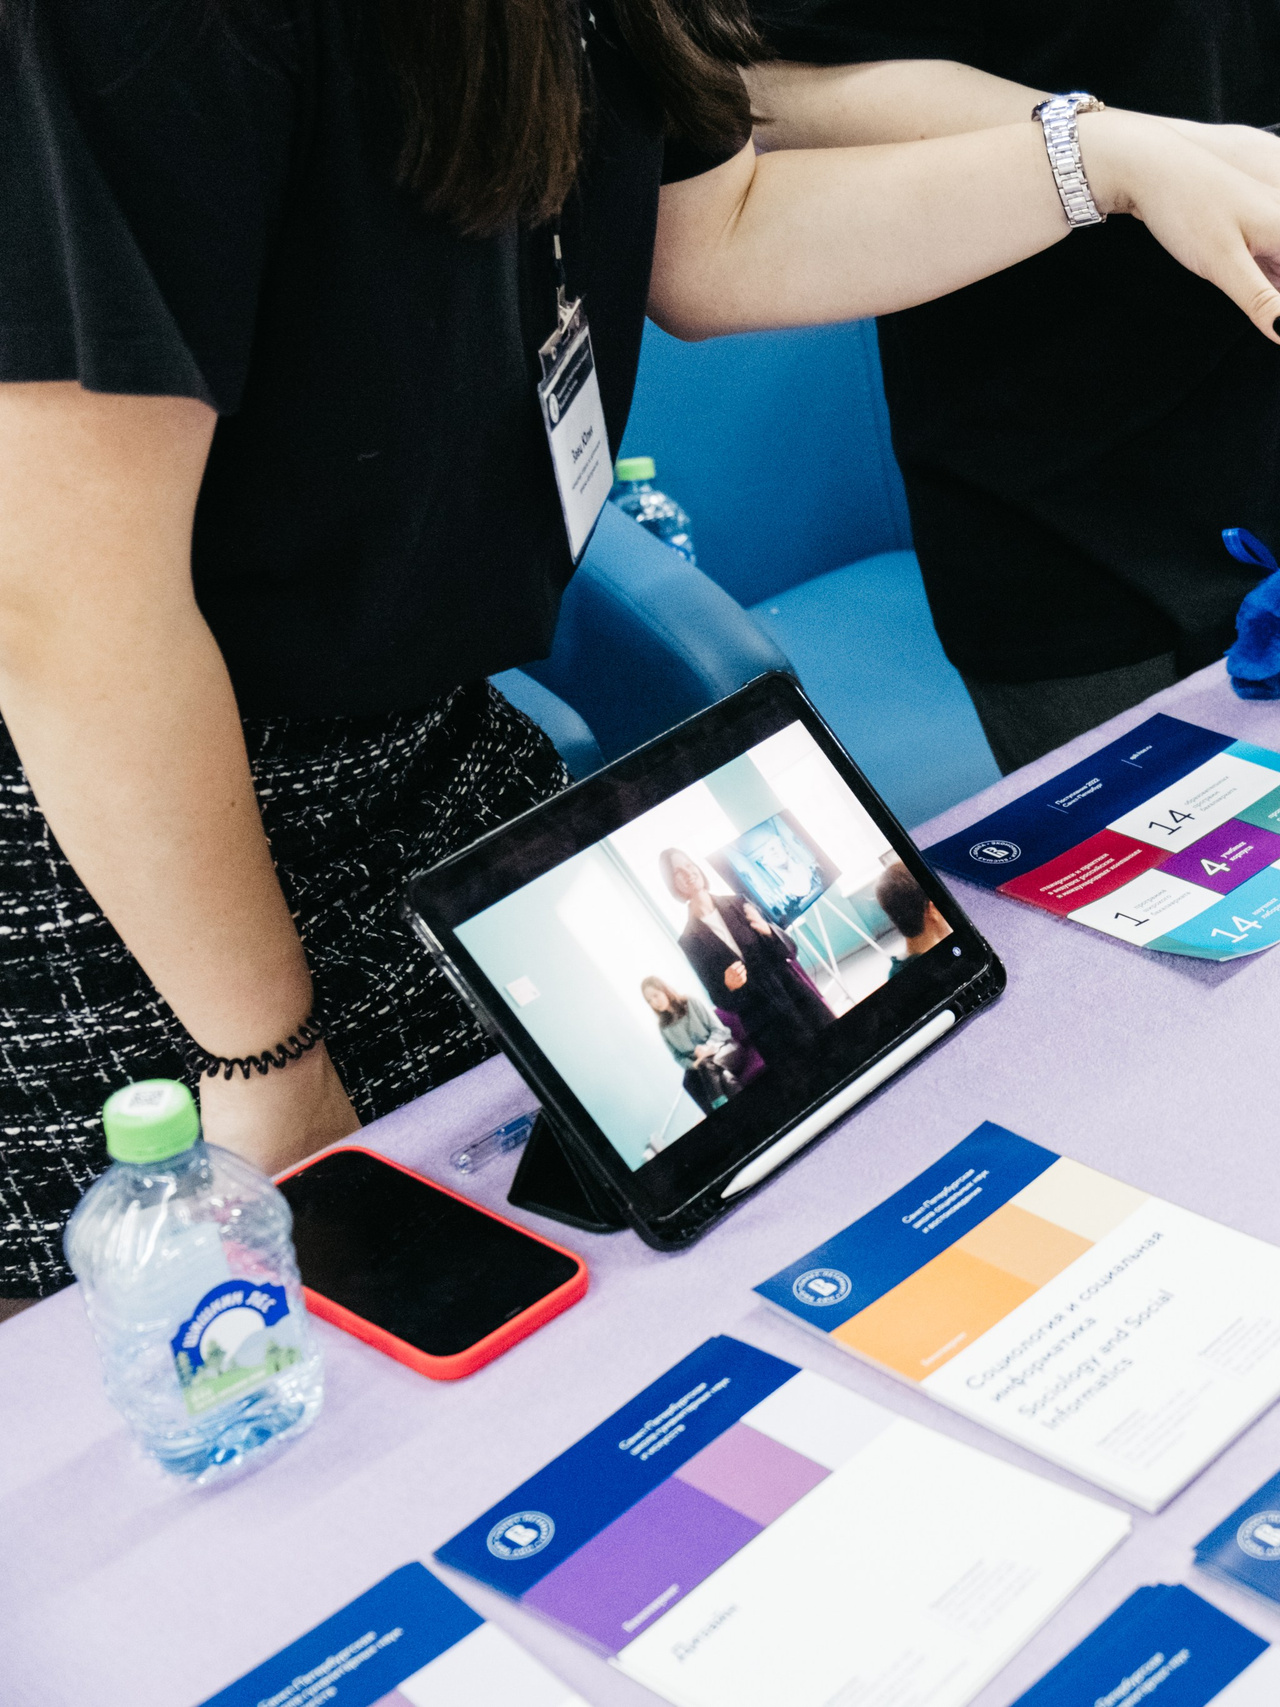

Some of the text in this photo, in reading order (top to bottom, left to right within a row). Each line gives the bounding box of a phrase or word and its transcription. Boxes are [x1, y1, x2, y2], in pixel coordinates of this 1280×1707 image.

[1148, 809, 1196, 835] 14
[1200, 859, 1230, 876] 4
[1114, 912, 1150, 927] 1
[1210, 915, 1263, 943] 14
[182, 1290, 244, 1349] ШИШКИН
[961, 1229, 1165, 1392] Социология и социальная
[990, 1315, 1098, 1403] информатика
[1013, 1287, 1174, 1419] Sociology and Social
[1038, 1356, 1135, 1430] Informatics
